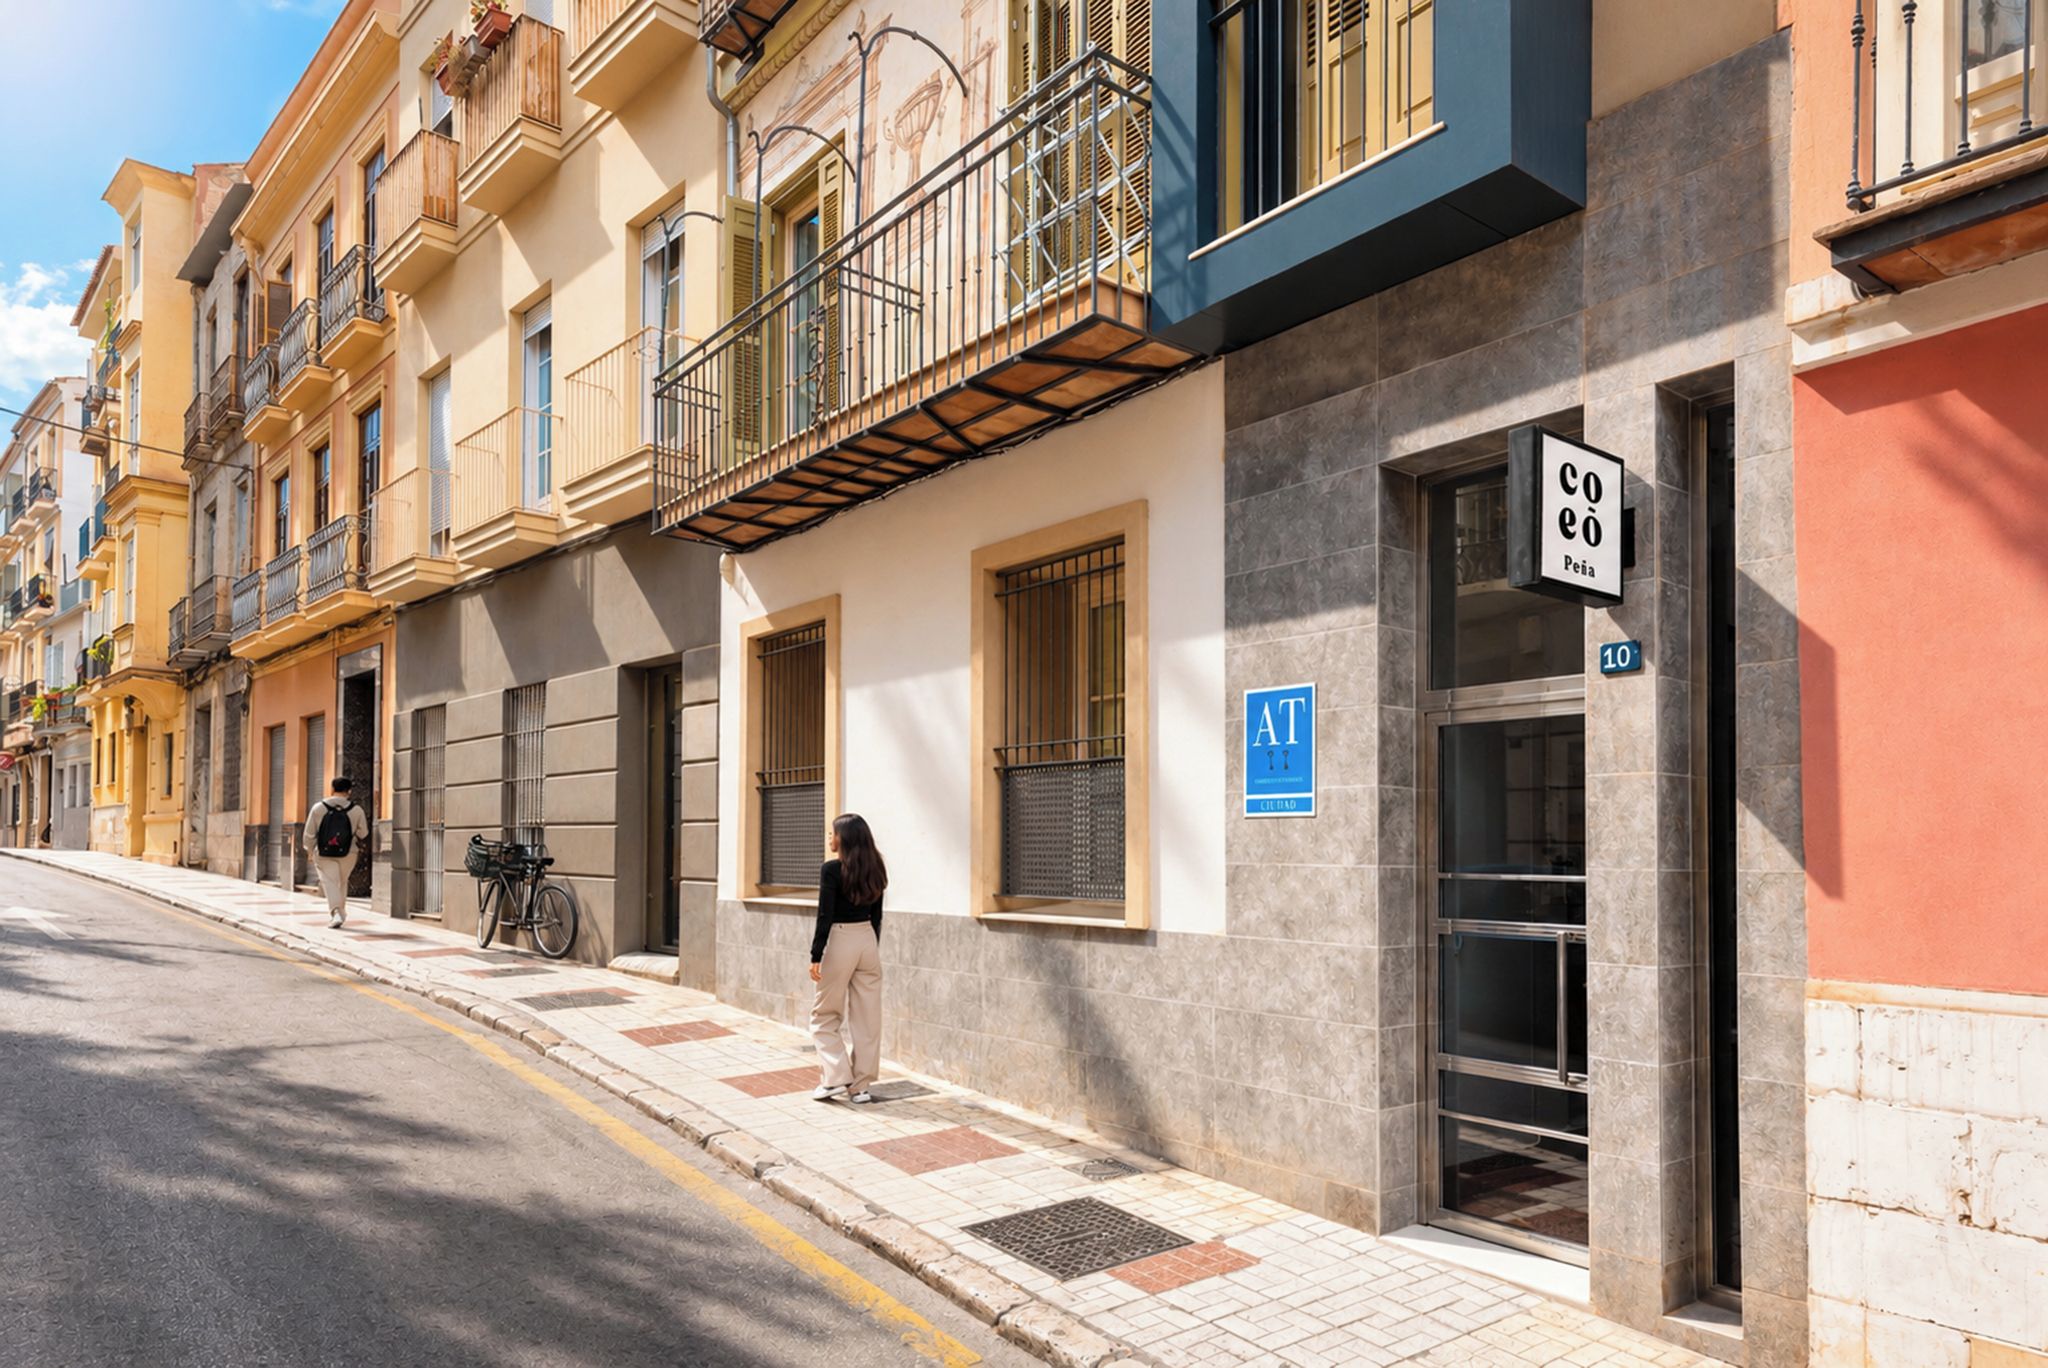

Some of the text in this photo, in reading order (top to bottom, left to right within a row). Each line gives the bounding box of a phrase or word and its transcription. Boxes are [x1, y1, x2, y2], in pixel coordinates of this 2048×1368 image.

[1559, 462, 1603, 504] co
[1564, 554, 1596, 578] Peña
[1603, 645, 1631, 668] 10
[1252, 697, 1307, 747] AT
